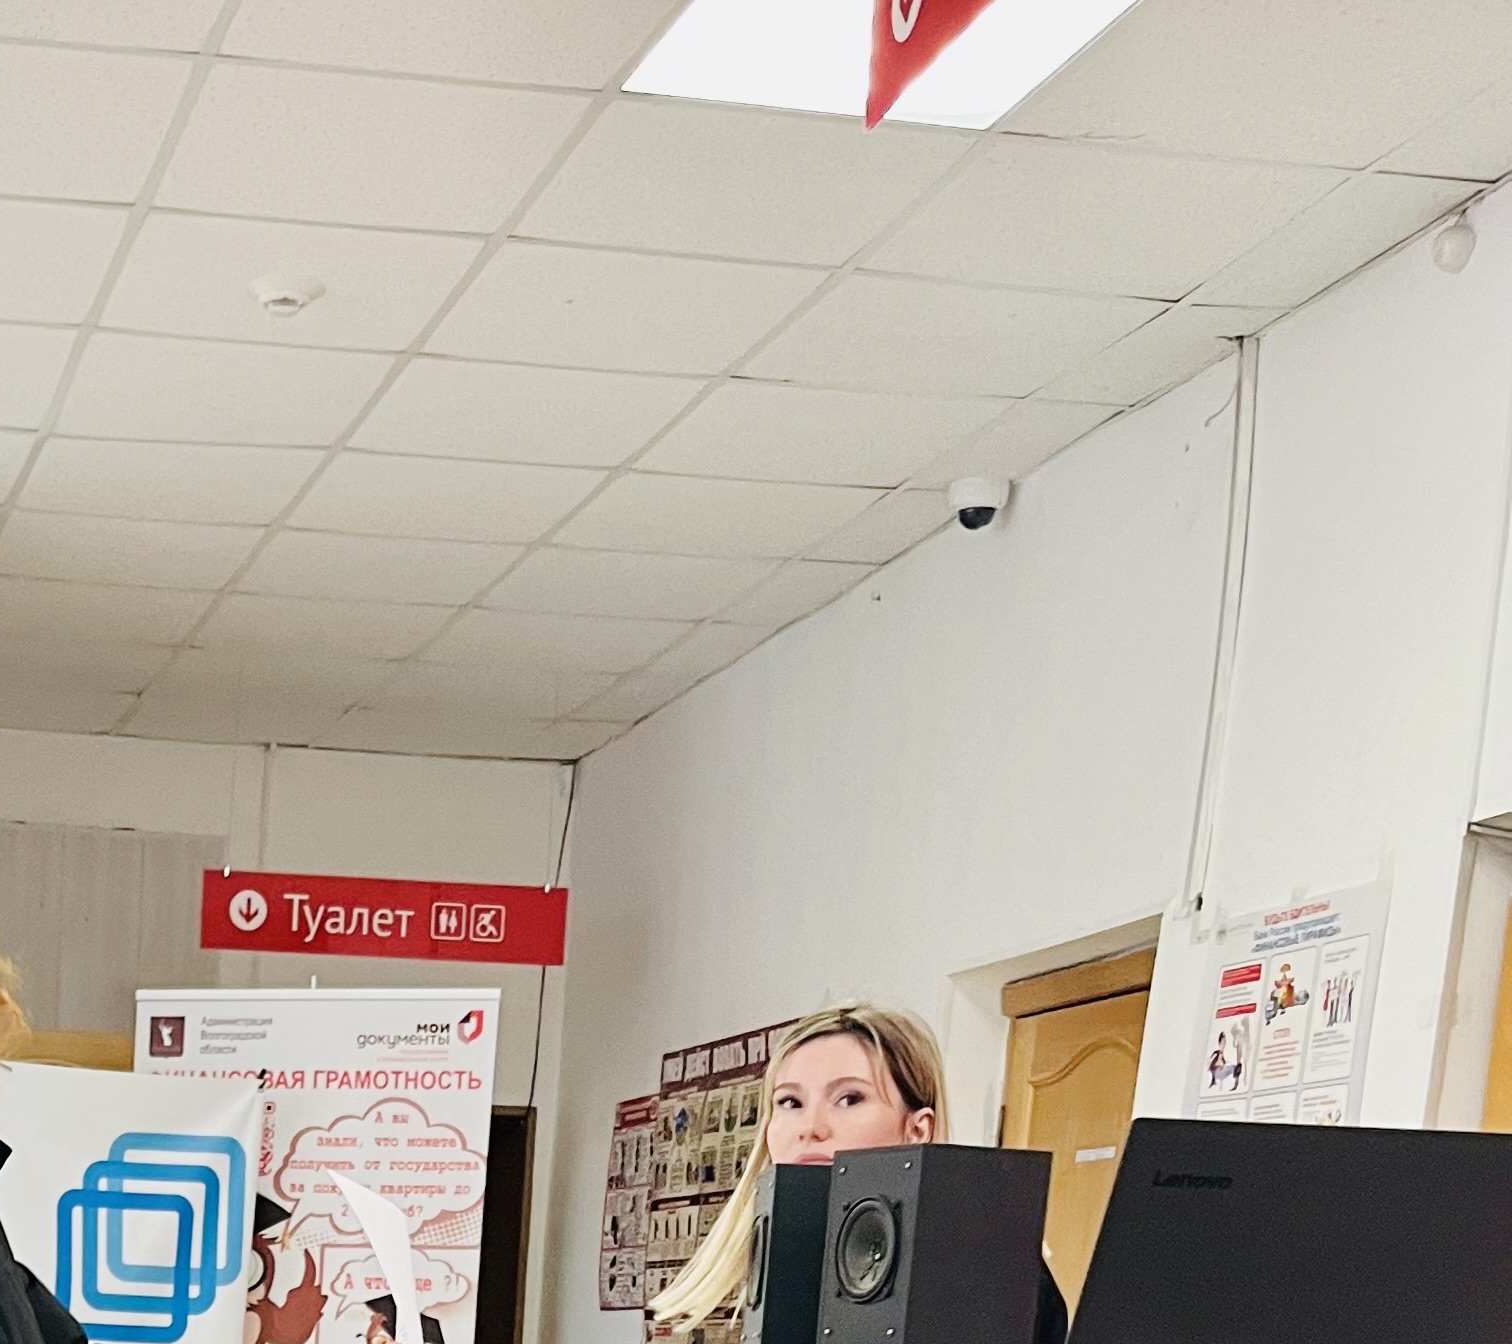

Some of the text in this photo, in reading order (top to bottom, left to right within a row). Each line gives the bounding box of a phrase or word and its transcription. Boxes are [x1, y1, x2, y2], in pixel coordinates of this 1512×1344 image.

[283, 893, 415, 943] Туалет
[356, 1034, 450, 1049] документы
[313, 1070, 482, 1091] ГРАМОТНОСТЬ
[374, 1111, 383, 1124] А
[374, 1137, 399, 1147] что
[407, 1137, 457, 1148] можете
[364, 1160, 381, 1170] от
[389, 1161, 480, 1174] государства
[1151, 1168, 1233, 1190] Lenovo
[379, 1184, 446, 1198] квартиры
[454, 1185, 471, 1195] до
[343, 1273, 354, 1290] А
